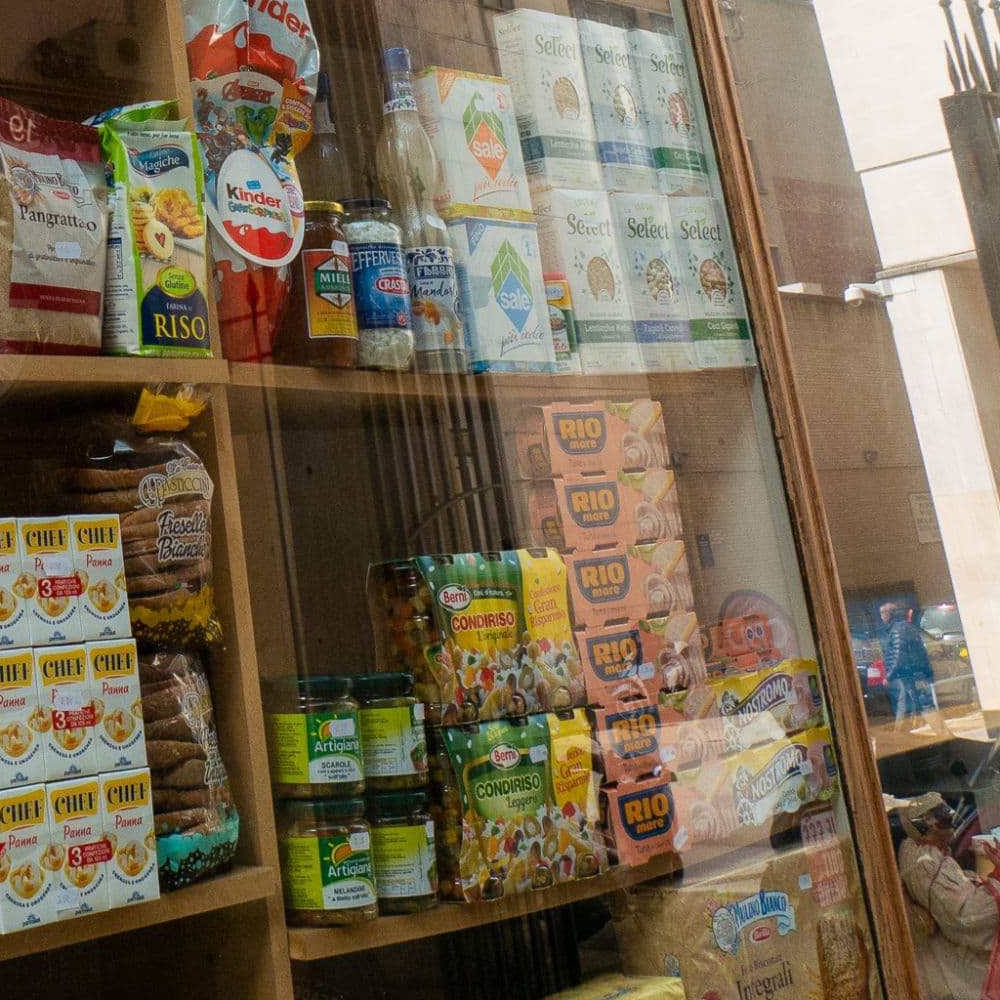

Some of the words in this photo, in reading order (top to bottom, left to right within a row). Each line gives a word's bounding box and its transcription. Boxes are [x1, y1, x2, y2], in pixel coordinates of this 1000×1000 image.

[535, 33, 577, 61] Select
[595, 43, 633, 70] Select
[650, 52, 687, 78] Select
[472, 136, 505, 160] sale
[138, 155, 181, 174] Magiche
[226, 183, 282, 209] Kinder
[627, 216, 670, 240] Select
[680, 218, 723, 241] Select
[164, 280, 190, 291] Glutine
[500, 286, 532, 312] sale
[153, 313, 206, 341] RISO
[558, 417, 602, 440] RIO
[570, 487, 616, 512] RIO
[25, 526, 69, 549] CHEF
[76, 524, 117, 546] CHEF
[86, 554, 113, 568] Panna
[579, 562, 625, 587] RIO
[40, 579, 53, 597] 3
[441, 588, 469, 606] Berni
[532, 599, 559, 616] Gran
[450, 611, 516, 633] CONDIRISO
[93, 650, 136, 673] CHEF
[592, 637, 638, 663] RIO
[42, 656, 86, 680] CHEF
[101, 682, 130, 697] Panna
[738, 676, 790, 726] NOSTROMO
[54, 710, 67, 729] 3
[610, 715, 656, 741] RIO
[493, 746, 518, 764] Berni
[558, 760, 584, 780] Gran
[751, 748, 804, 802] NOSTROMO
[106, 780, 149, 804] CHEF
[475, 773, 542, 801] CONDIRISO
[0, 798, 43, 825] CHEF
[54, 790, 97, 814] CHEF
[624, 792, 669, 821] RIO
[63, 825, 93, 841] Panna
[115, 814, 144, 831] Panna
[8, 834, 38, 851] Panna
[69, 845, 83, 867] 3
[732, 894, 760, 921] MULINO
[759, 889, 787, 916] BIANCO
[735, 958, 795, 1000] Integrali
